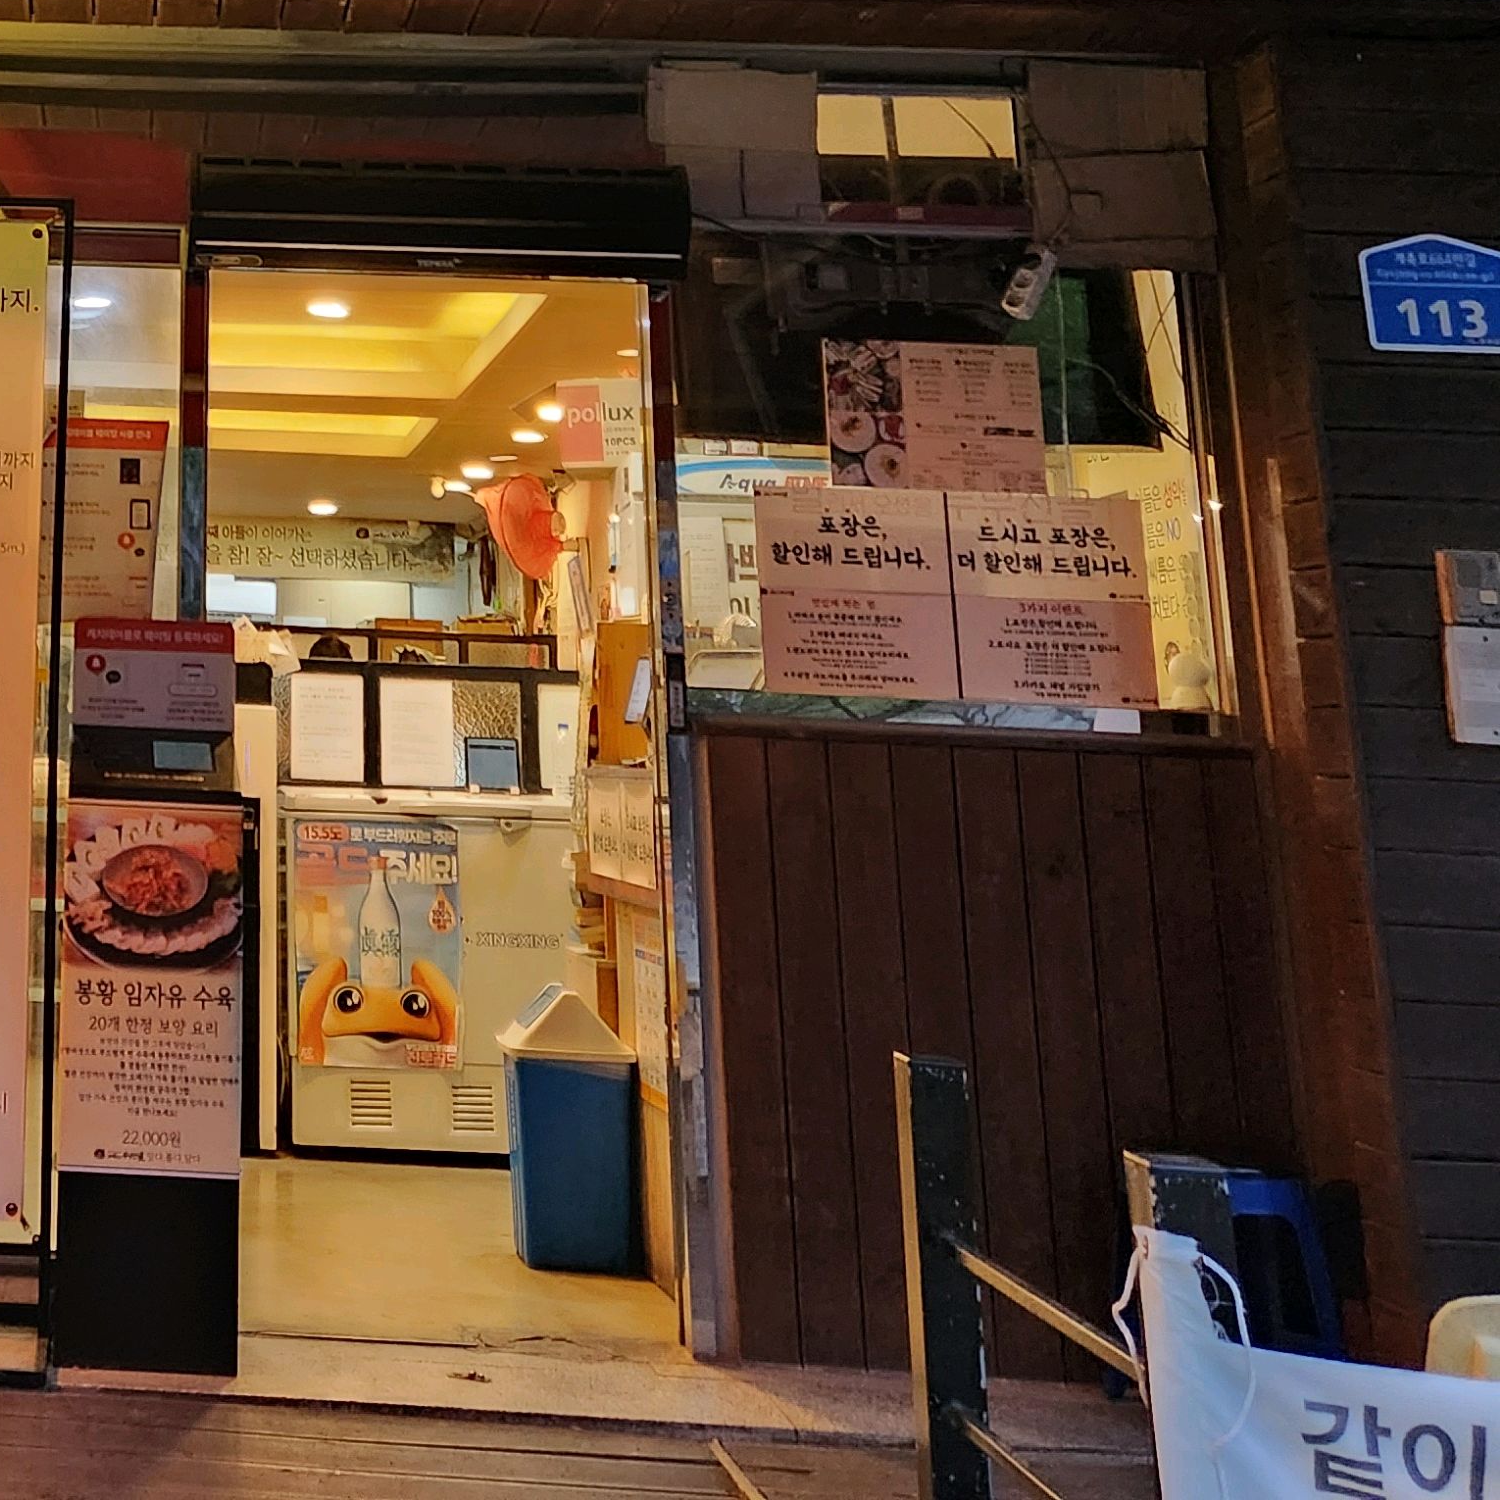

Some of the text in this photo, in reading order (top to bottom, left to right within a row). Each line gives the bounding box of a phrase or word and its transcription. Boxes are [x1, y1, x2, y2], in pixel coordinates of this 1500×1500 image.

[1395, 298, 1489, 338] 113
[566, 401, 635, 429] pollux
[604, 436, 637, 447] 10PCS
[221, 525, 258, 542] 아들이
[818, 513, 888, 542] 포장은,
[977, 523, 1116, 552] 드시고 포장은,
[227, 544, 250, 566] 참!
[771, 540, 833, 566] 할인해
[840, 544, 931, 570] 드립니다.
[957, 550, 1138, 579] 더 할인해 드립니다.
[1050, 603, 1083, 615] 이벤트
[303, 824, 343, 841] 15.5도
[378, 848, 458, 886] 주세요!
[476, 931, 560, 949] XINGXING
[74, 979, 236, 1013] 봉황 임자유 수육
[88, 1015, 219, 1038] 20개 한정 보양 요리
